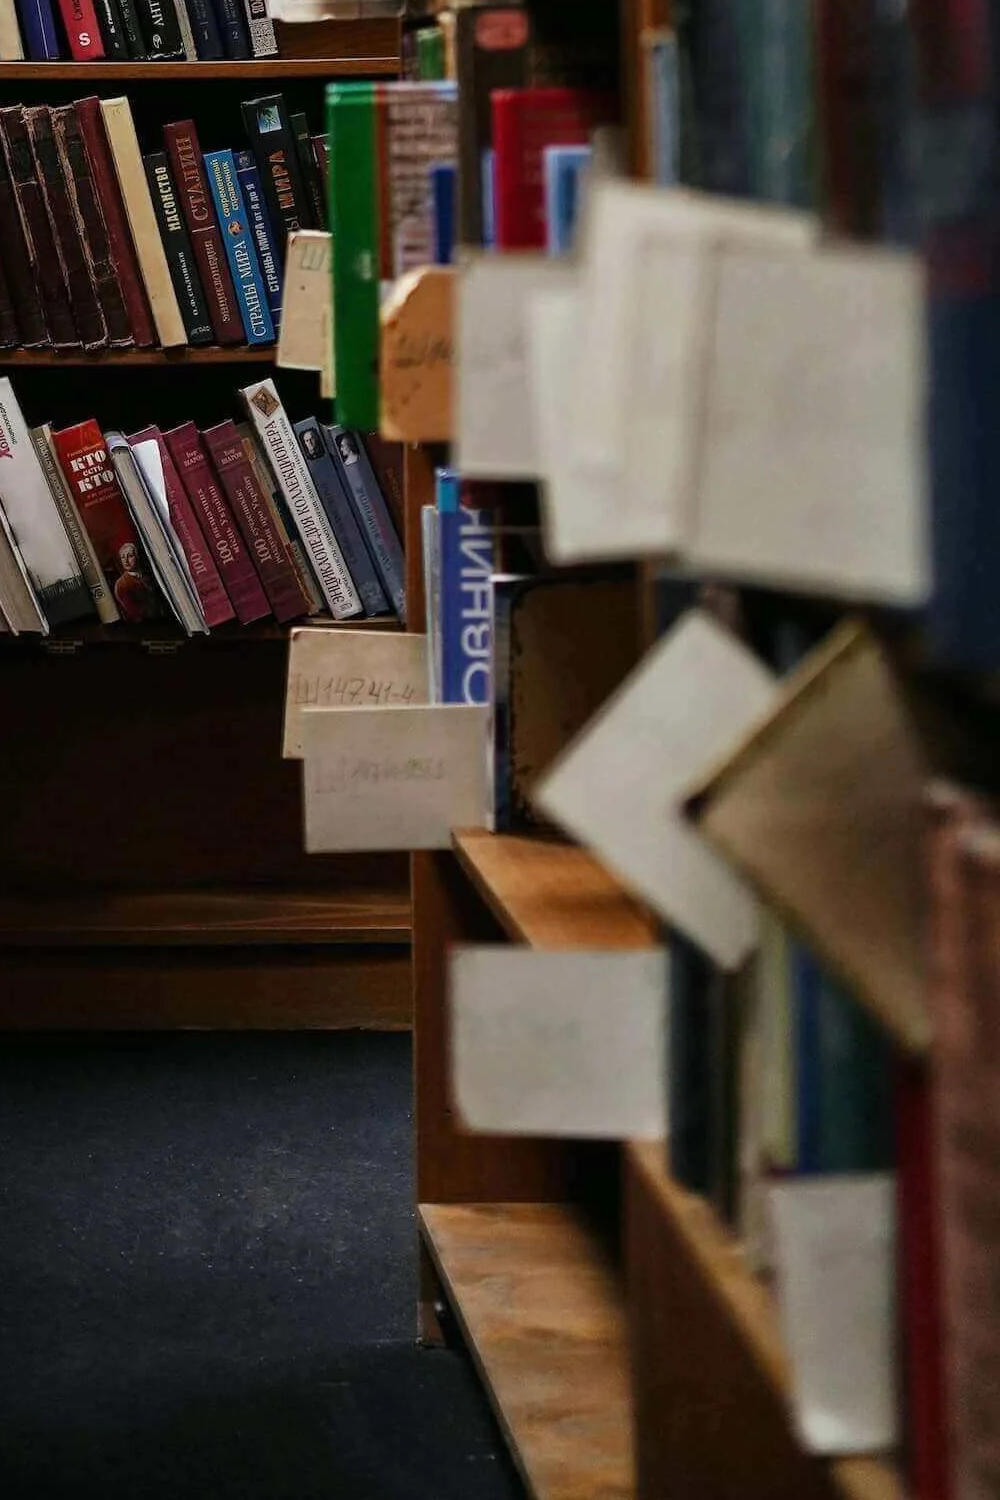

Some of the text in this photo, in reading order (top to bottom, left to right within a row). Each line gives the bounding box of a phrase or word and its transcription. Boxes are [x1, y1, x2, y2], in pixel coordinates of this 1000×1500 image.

[154, 166, 182, 232] МАСОНСТВО
[175, 137, 208, 221] СТАЛИН
[210, 159, 231, 217] современный
[221, 161, 240, 211] справочник
[267, 149, 295, 209] МИРА
[253, 223, 271, 251] МИРА
[233, 241, 267, 337] СТРАНЫ МИРА
[261, 252, 280, 292] СТРАНЫ
[70, 450, 107, 473] КТО
[77, 470, 114, 492] КТО
[83, 465, 104, 477] есть
[266, 420, 314, 515] КОЛЛЕКЦИОНЕРА
[257, 511, 270, 527] про
[190, 553, 208, 575] 100
[216, 540, 235, 565] 100
[253, 538, 273, 564] 100
[299, 516, 346, 604] ЭНЦИКЛОПЕДИЯ
